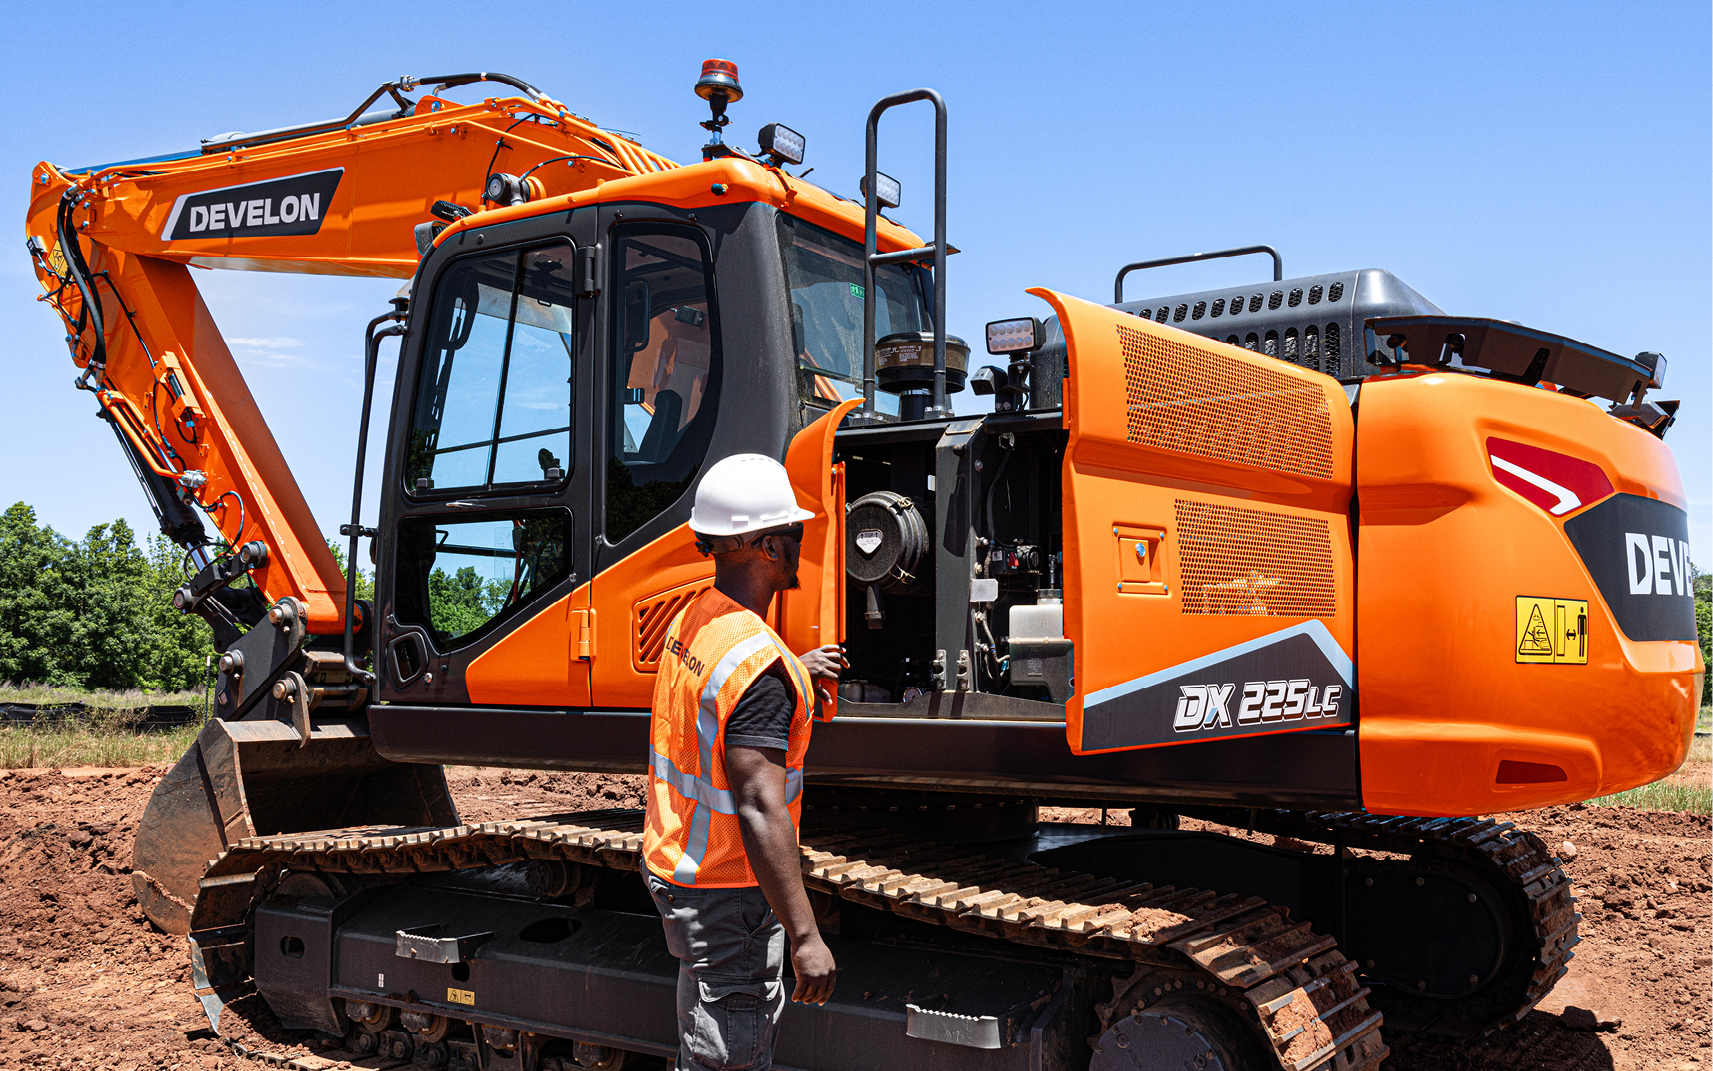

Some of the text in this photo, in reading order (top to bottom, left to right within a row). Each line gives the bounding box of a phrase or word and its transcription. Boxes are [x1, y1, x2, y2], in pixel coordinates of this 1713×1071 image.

[189, 193, 320, 232] DEVELON
[666, 635, 705, 677] DEELON
[1173, 683, 1236, 733] DX
